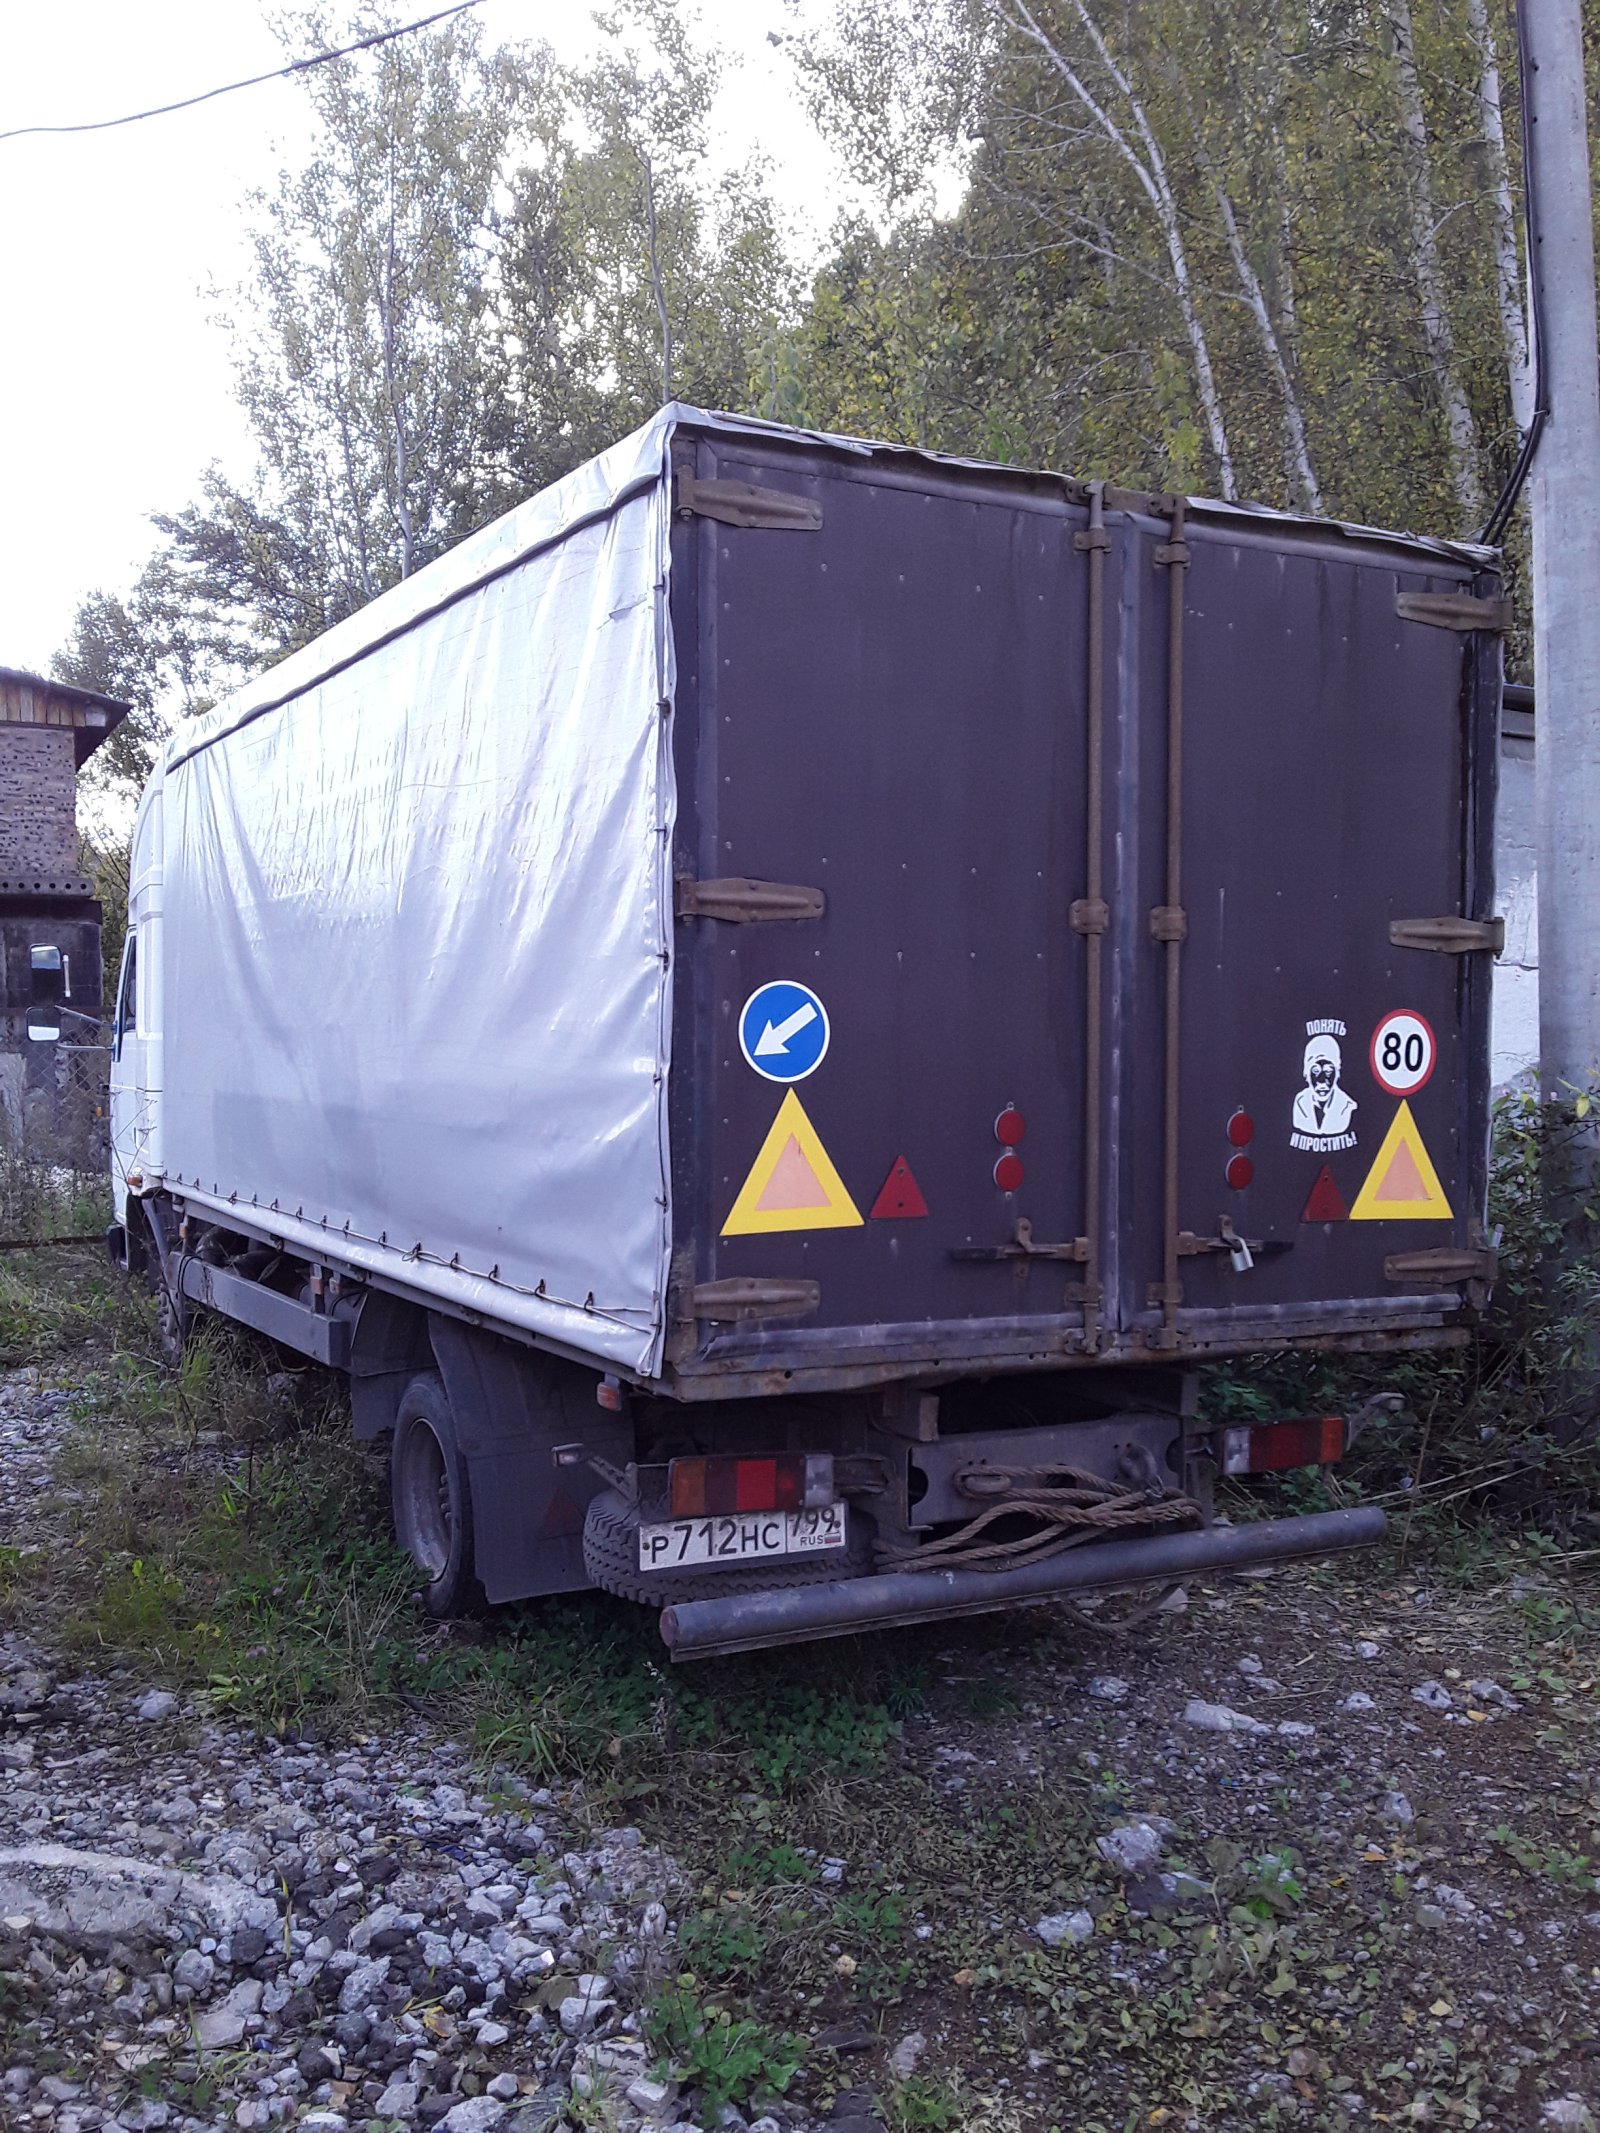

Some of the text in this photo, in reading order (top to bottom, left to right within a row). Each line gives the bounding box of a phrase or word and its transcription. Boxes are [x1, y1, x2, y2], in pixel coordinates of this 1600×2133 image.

[1306, 1019, 1347, 1036] ПОНЯТЬ
[1382, 1032, 1423, 1072] 80
[800, 1535, 824, 1546] RUS
